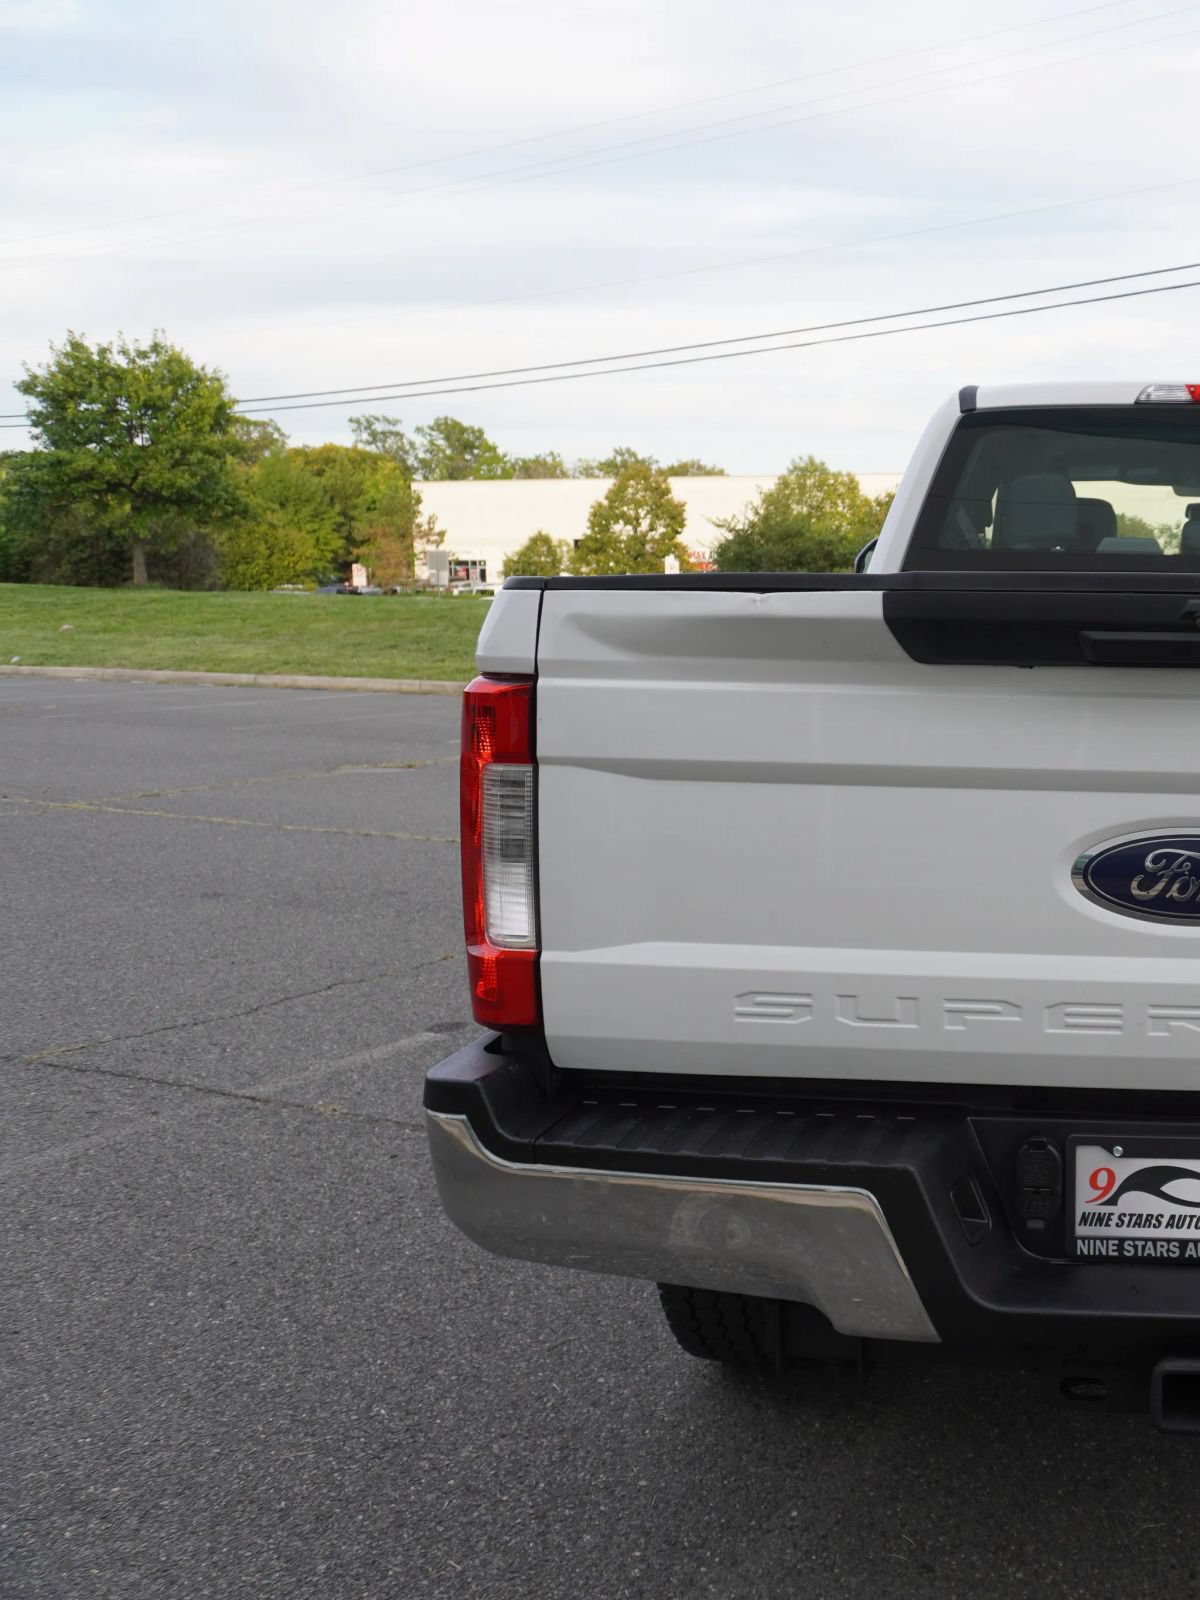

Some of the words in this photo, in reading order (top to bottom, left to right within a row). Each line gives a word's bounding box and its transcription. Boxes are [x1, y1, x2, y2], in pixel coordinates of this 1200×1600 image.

[1084, 1167, 1117, 1204] 9
[1078, 1211, 1114, 1228] NINE
[1115, 1212, 1164, 1229] STARS
[1076, 1239, 1119, 1256] NINE
[1123, 1240, 1180, 1258] STARS
